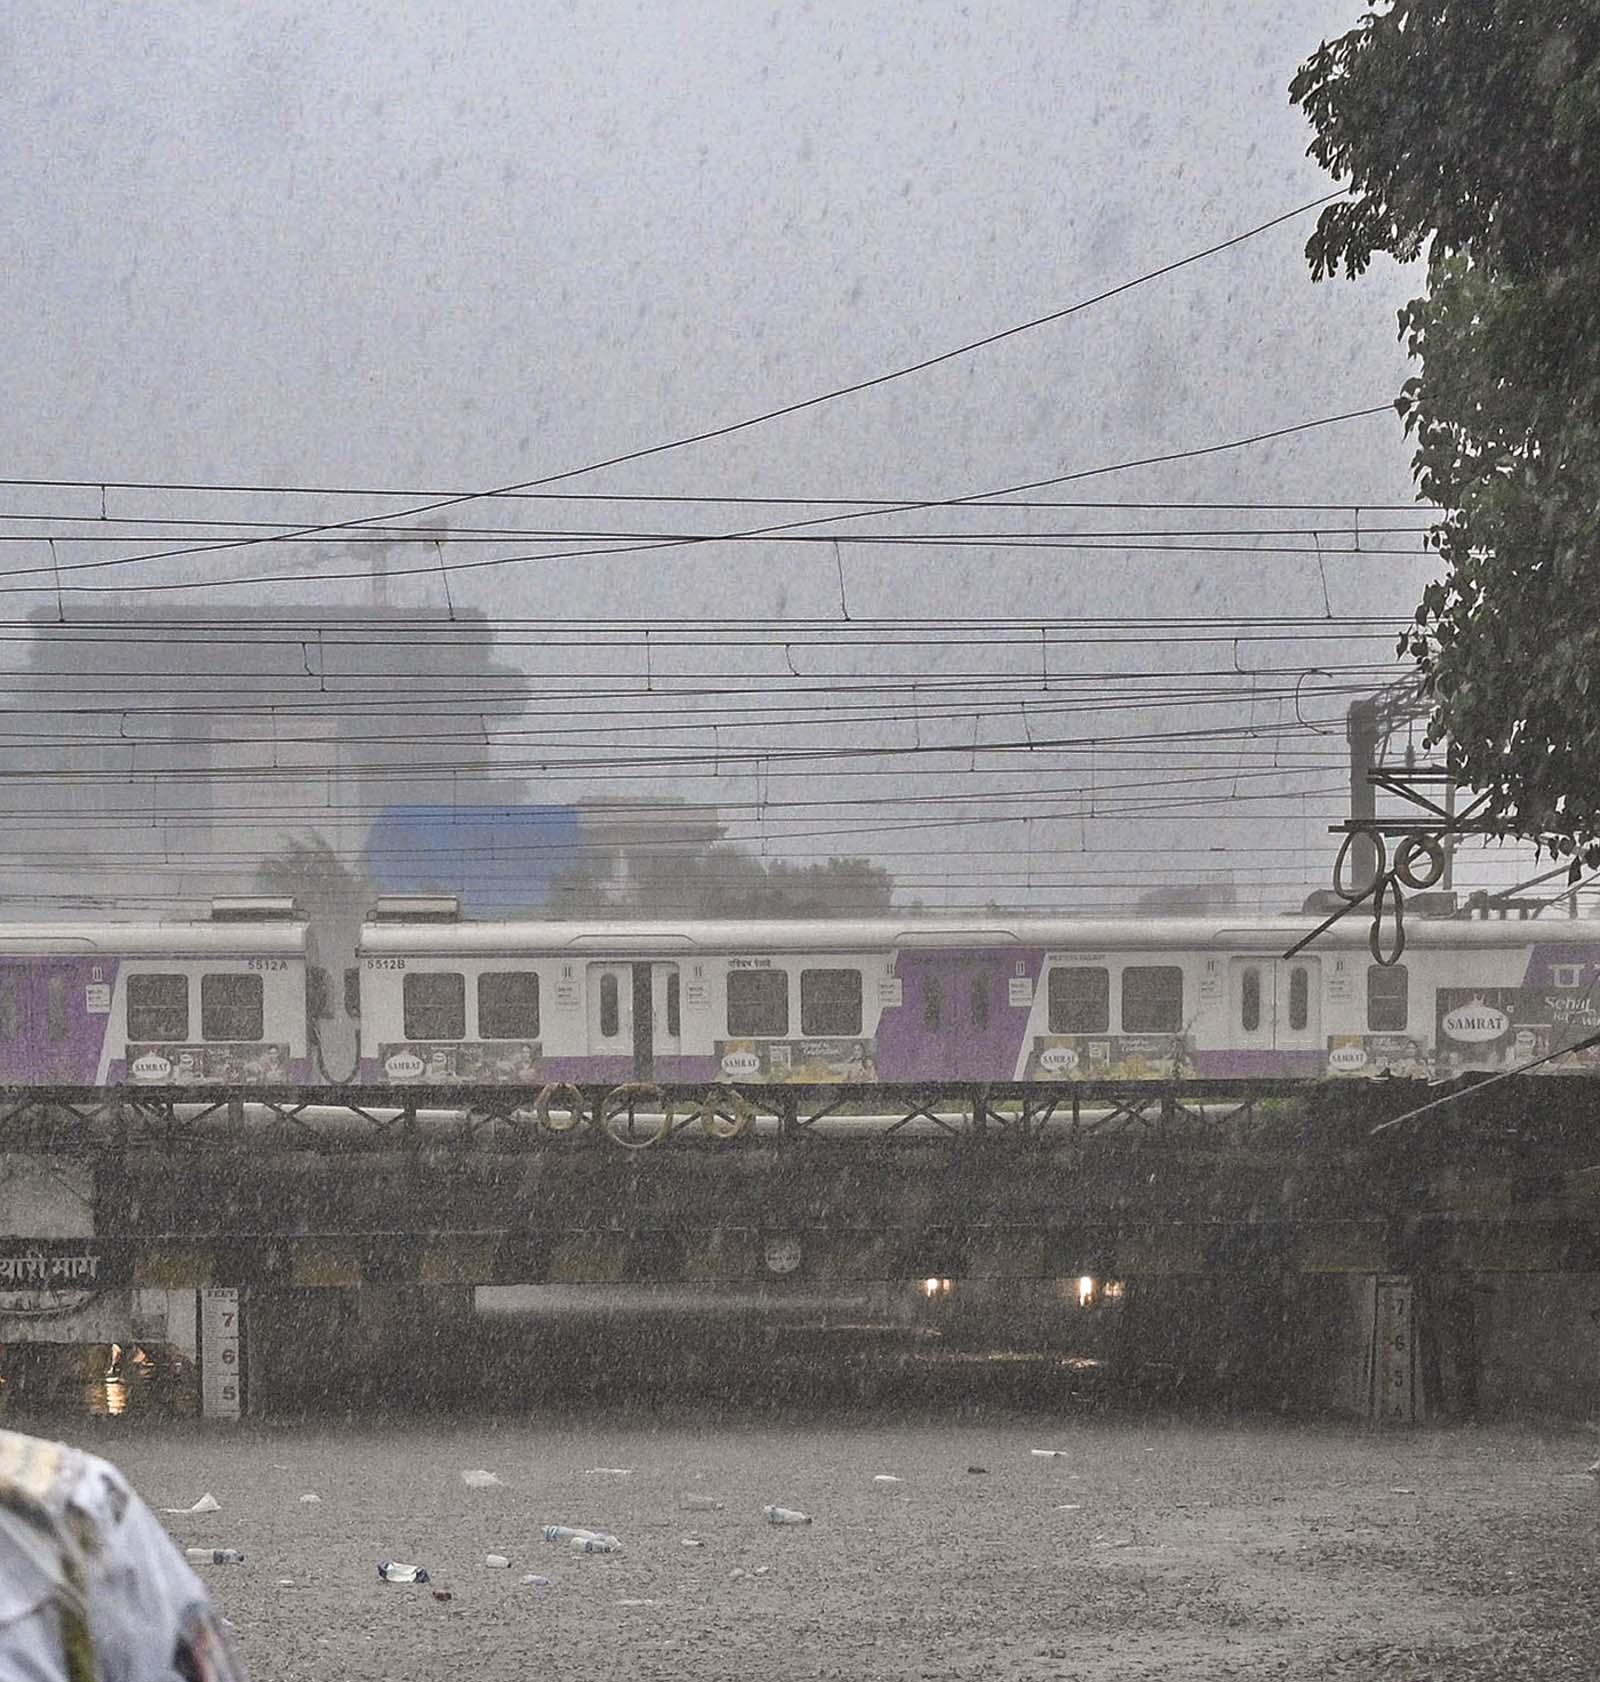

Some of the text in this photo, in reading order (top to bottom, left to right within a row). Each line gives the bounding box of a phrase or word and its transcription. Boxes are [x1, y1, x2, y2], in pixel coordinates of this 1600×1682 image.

[248, 960, 288, 971] 5512A
[1446, 1016, 1503, 1030] SAMRAT
[135, 1063, 167, 1072] SAMRAT
[724, 1059, 756, 1067] SAMRAT
[222, 1312, 235, 1328] 7
[1395, 1335, 1405, 1352] 6
[222, 1349, 236, 1365] 6
[1394, 1370, 1403, 1387] 5
[222, 1385, 236, 1401] 5
